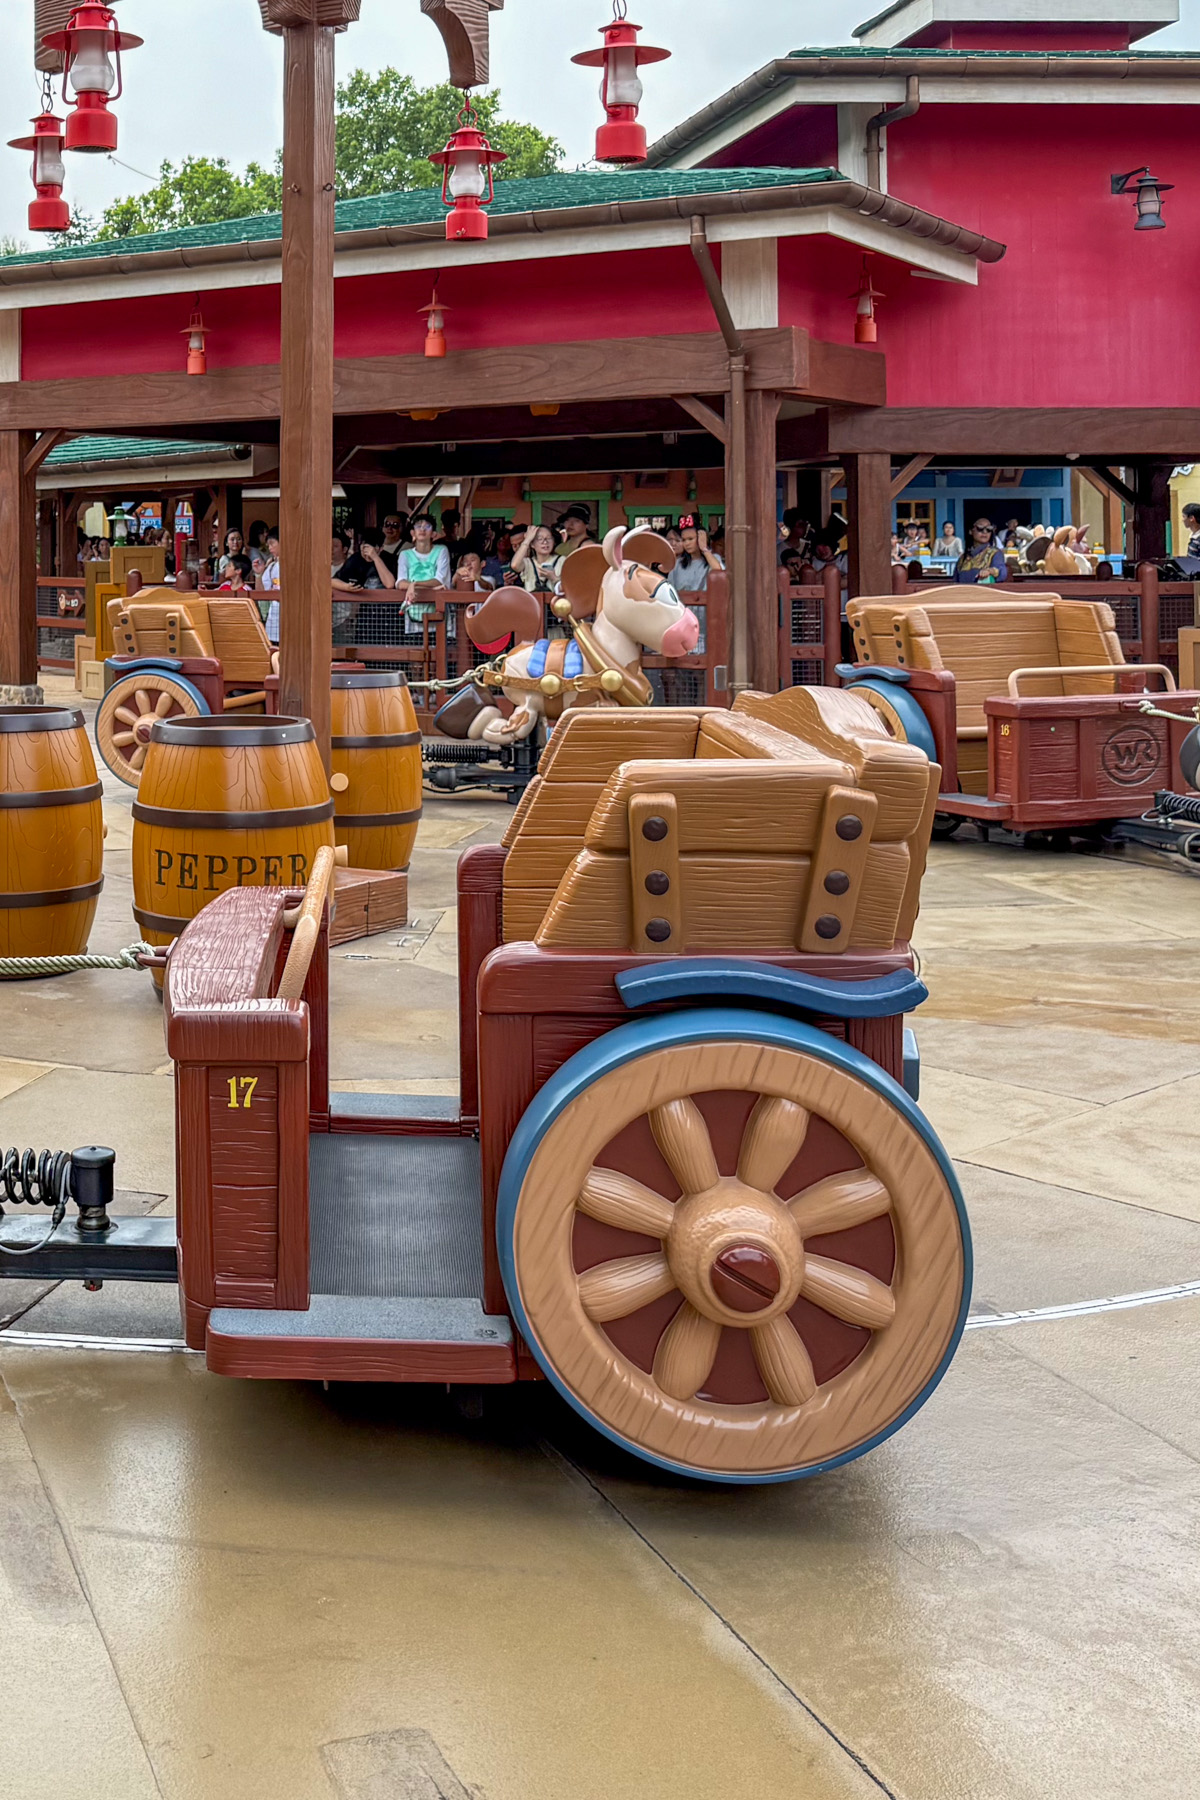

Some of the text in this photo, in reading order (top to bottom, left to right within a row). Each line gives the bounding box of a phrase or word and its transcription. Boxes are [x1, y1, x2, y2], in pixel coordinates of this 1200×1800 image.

[1000, 724, 1010, 736] 16
[155, 849, 312, 891] PEPPER
[227, 1076, 258, 1108] 17
